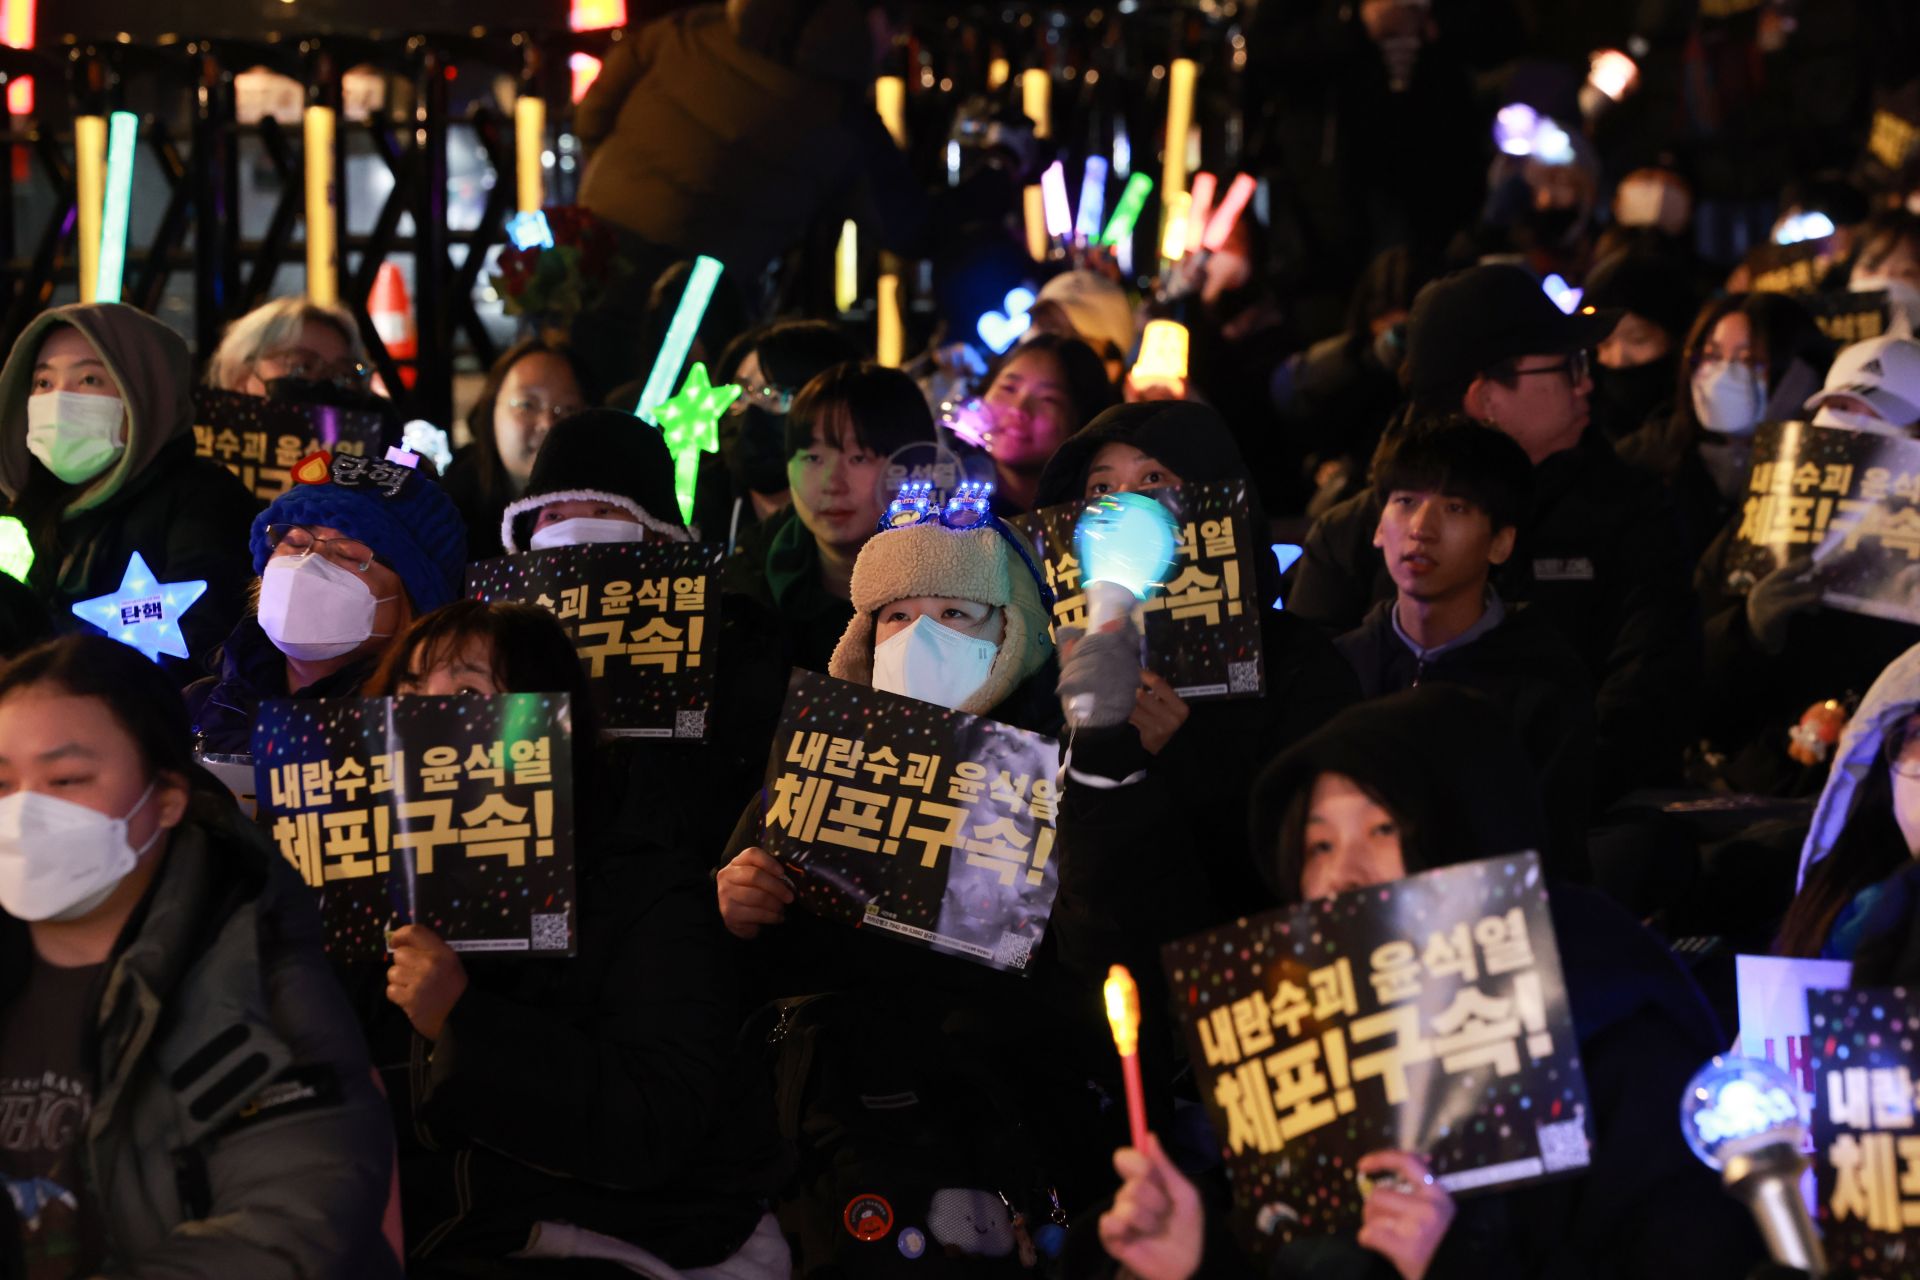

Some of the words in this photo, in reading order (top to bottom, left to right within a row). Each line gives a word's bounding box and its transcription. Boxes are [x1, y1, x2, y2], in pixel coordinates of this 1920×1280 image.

[331, 453, 411, 498] 탄핵
[1859, 466, 1920, 504] 윤석
[1173, 516, 1237, 561] 석열
[121, 601, 163, 626] 탄핵
[600, 575, 706, 617] 윤석열
[270, 750, 405, 809] 내란수괴
[420, 737, 552, 792] 윤석열
[785, 731, 941, 794] 내란수괴
[948, 761, 1061, 821] 윤석열
[1197, 956, 1359, 1066] 내란수괴
[1369, 906, 1535, 1005] 윤석열
[1827, 1065, 1920, 1129] 내란
